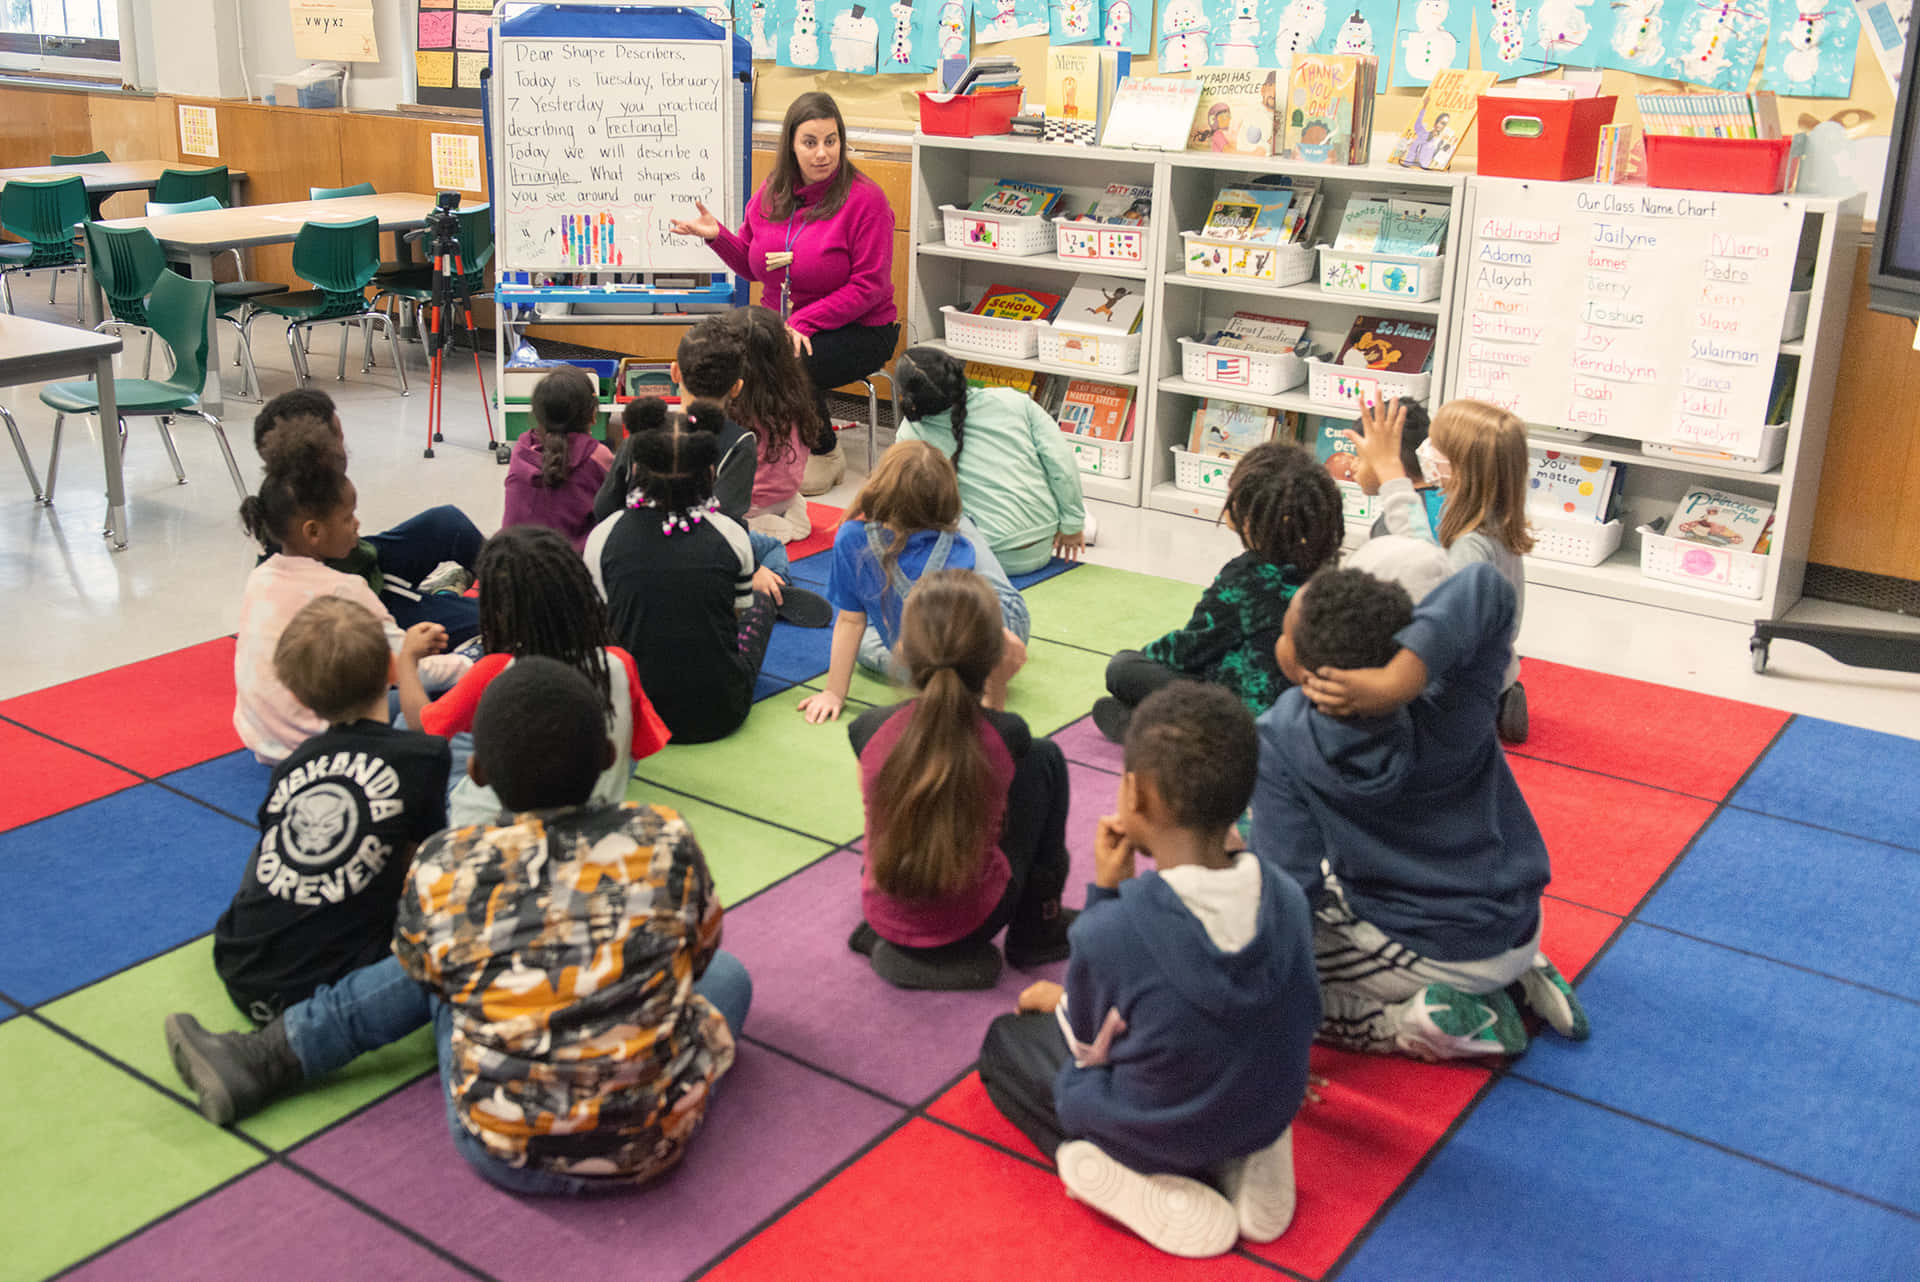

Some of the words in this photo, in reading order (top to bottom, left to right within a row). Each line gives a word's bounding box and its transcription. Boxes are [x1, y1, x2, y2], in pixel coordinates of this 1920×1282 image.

[516, 44, 552, 62] Dear
[562, 45, 605, 64] Shape
[515, 71, 556, 94] Today
[568, 75, 581, 87] is
[661, 73, 720, 94] February
[1211, 72, 1230, 84] PAPI
[1232, 72, 1251, 83] HAS
[1296, 62, 1342, 88] THANK
[1201, 83, 1262, 97] MOTORCYCLE
[530, 95, 604, 121] Yesterday
[620, 104, 644, 116] you
[658, 99, 718, 116] practiced
[508, 122, 575, 146] describing
[589, 125, 596, 135] a
[507, 143, 550, 167] Today
[564, 144, 584, 159] we
[600, 144, 624, 159] will
[637, 144, 690, 160] describe
[699, 150, 709, 160] a
[590, 165, 623, 181] What
[638, 165, 681, 185] shapes
[692, 166, 705, 182] do
[512, 191, 538, 206] you
[546, 191, 566, 202] see
[577, 188, 619, 202] around
[634, 192, 656, 202] our
[671, 187, 712, 202] room?
[991, 192, 1031, 210] ABC
[1577, 192, 1600, 210] Our
[1604, 194, 1635, 213] Class
[1641, 197, 1673, 215] Name
[1678, 198, 1717, 217] Chart
[1214, 214, 1250, 226] Koalas
[660, 233, 688, 247] Miss
[1592, 222, 1656, 249] Jailyne
[1712, 232, 1769, 258] Maria
[1480, 243, 1533, 265] Adoma
[1477, 266, 1532, 290] Alayah
[1704, 259, 1749, 281] Pedro
[989, 299, 1038, 315] SCHOOL
[1581, 301, 1645, 325] Joshua
[1376, 321, 1392, 335] So
[1394, 323, 1435, 341] Much!
[1690, 339, 1760, 363] Sulaiman
[1539, 459, 1567, 471] you
[1536, 471, 1583, 486] matter
[266, 752, 404, 823] WAKANDA
